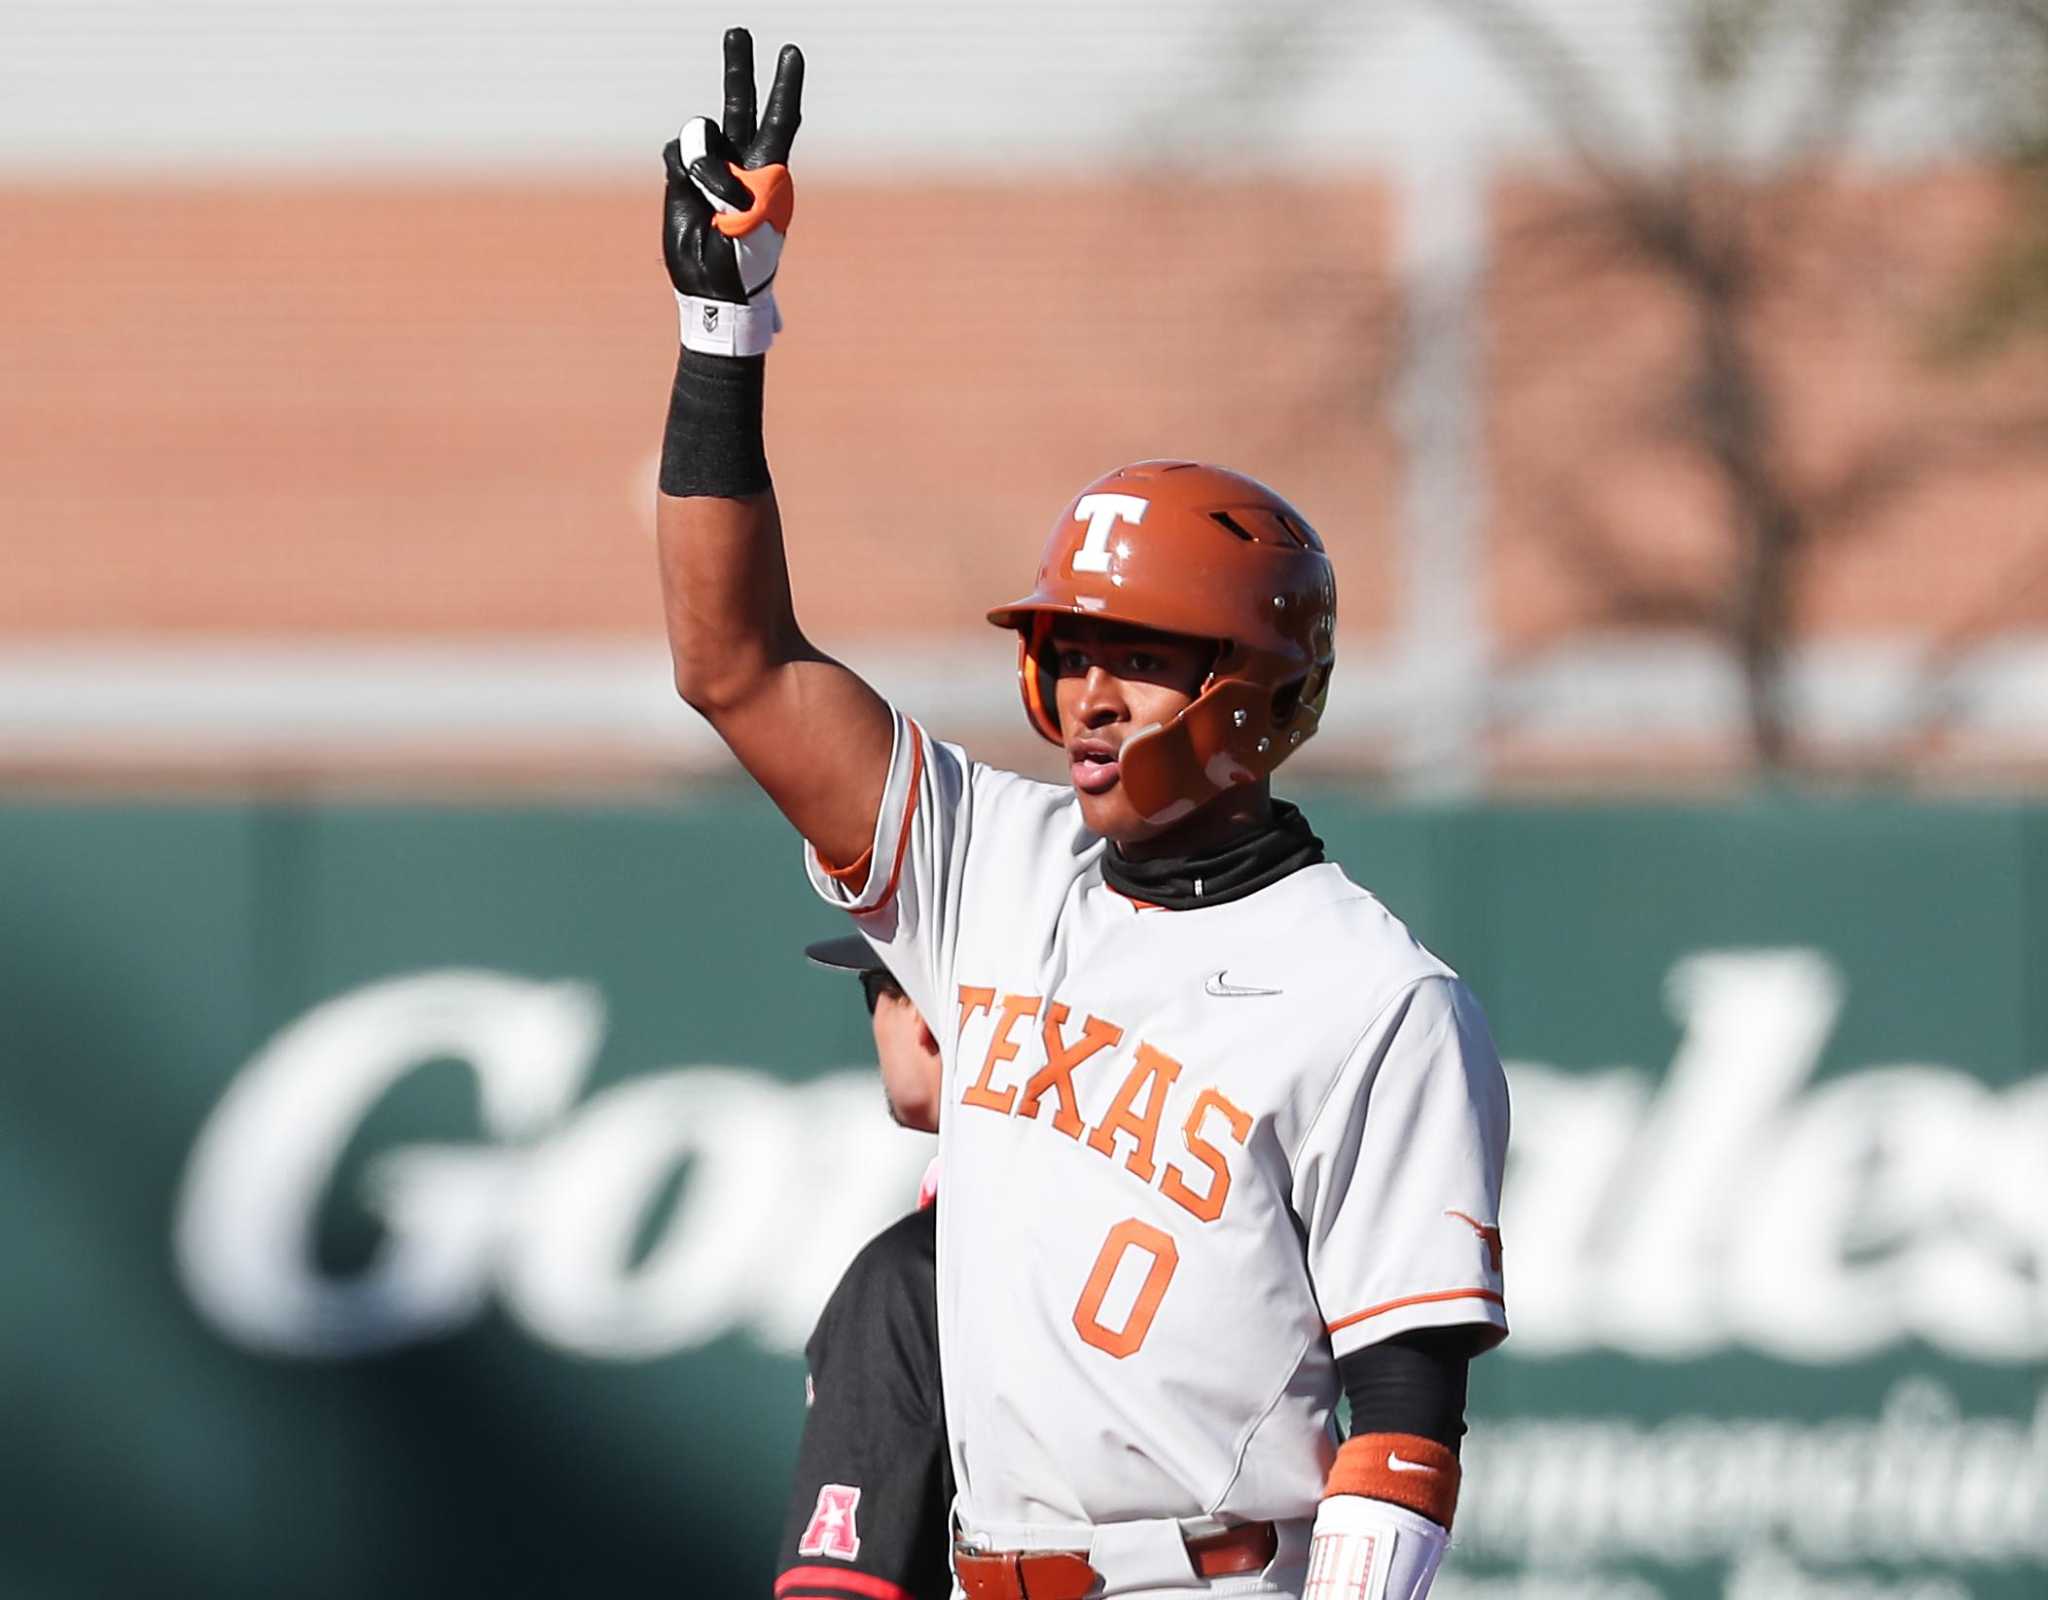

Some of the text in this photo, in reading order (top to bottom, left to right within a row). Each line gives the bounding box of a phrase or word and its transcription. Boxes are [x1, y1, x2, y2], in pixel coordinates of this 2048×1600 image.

[1072, 493, 1150, 572] T
[958, 984, 1254, 1224] TEXAS
[1071, 1217, 1180, 1359] 0
[798, 1484, 861, 1562] A
